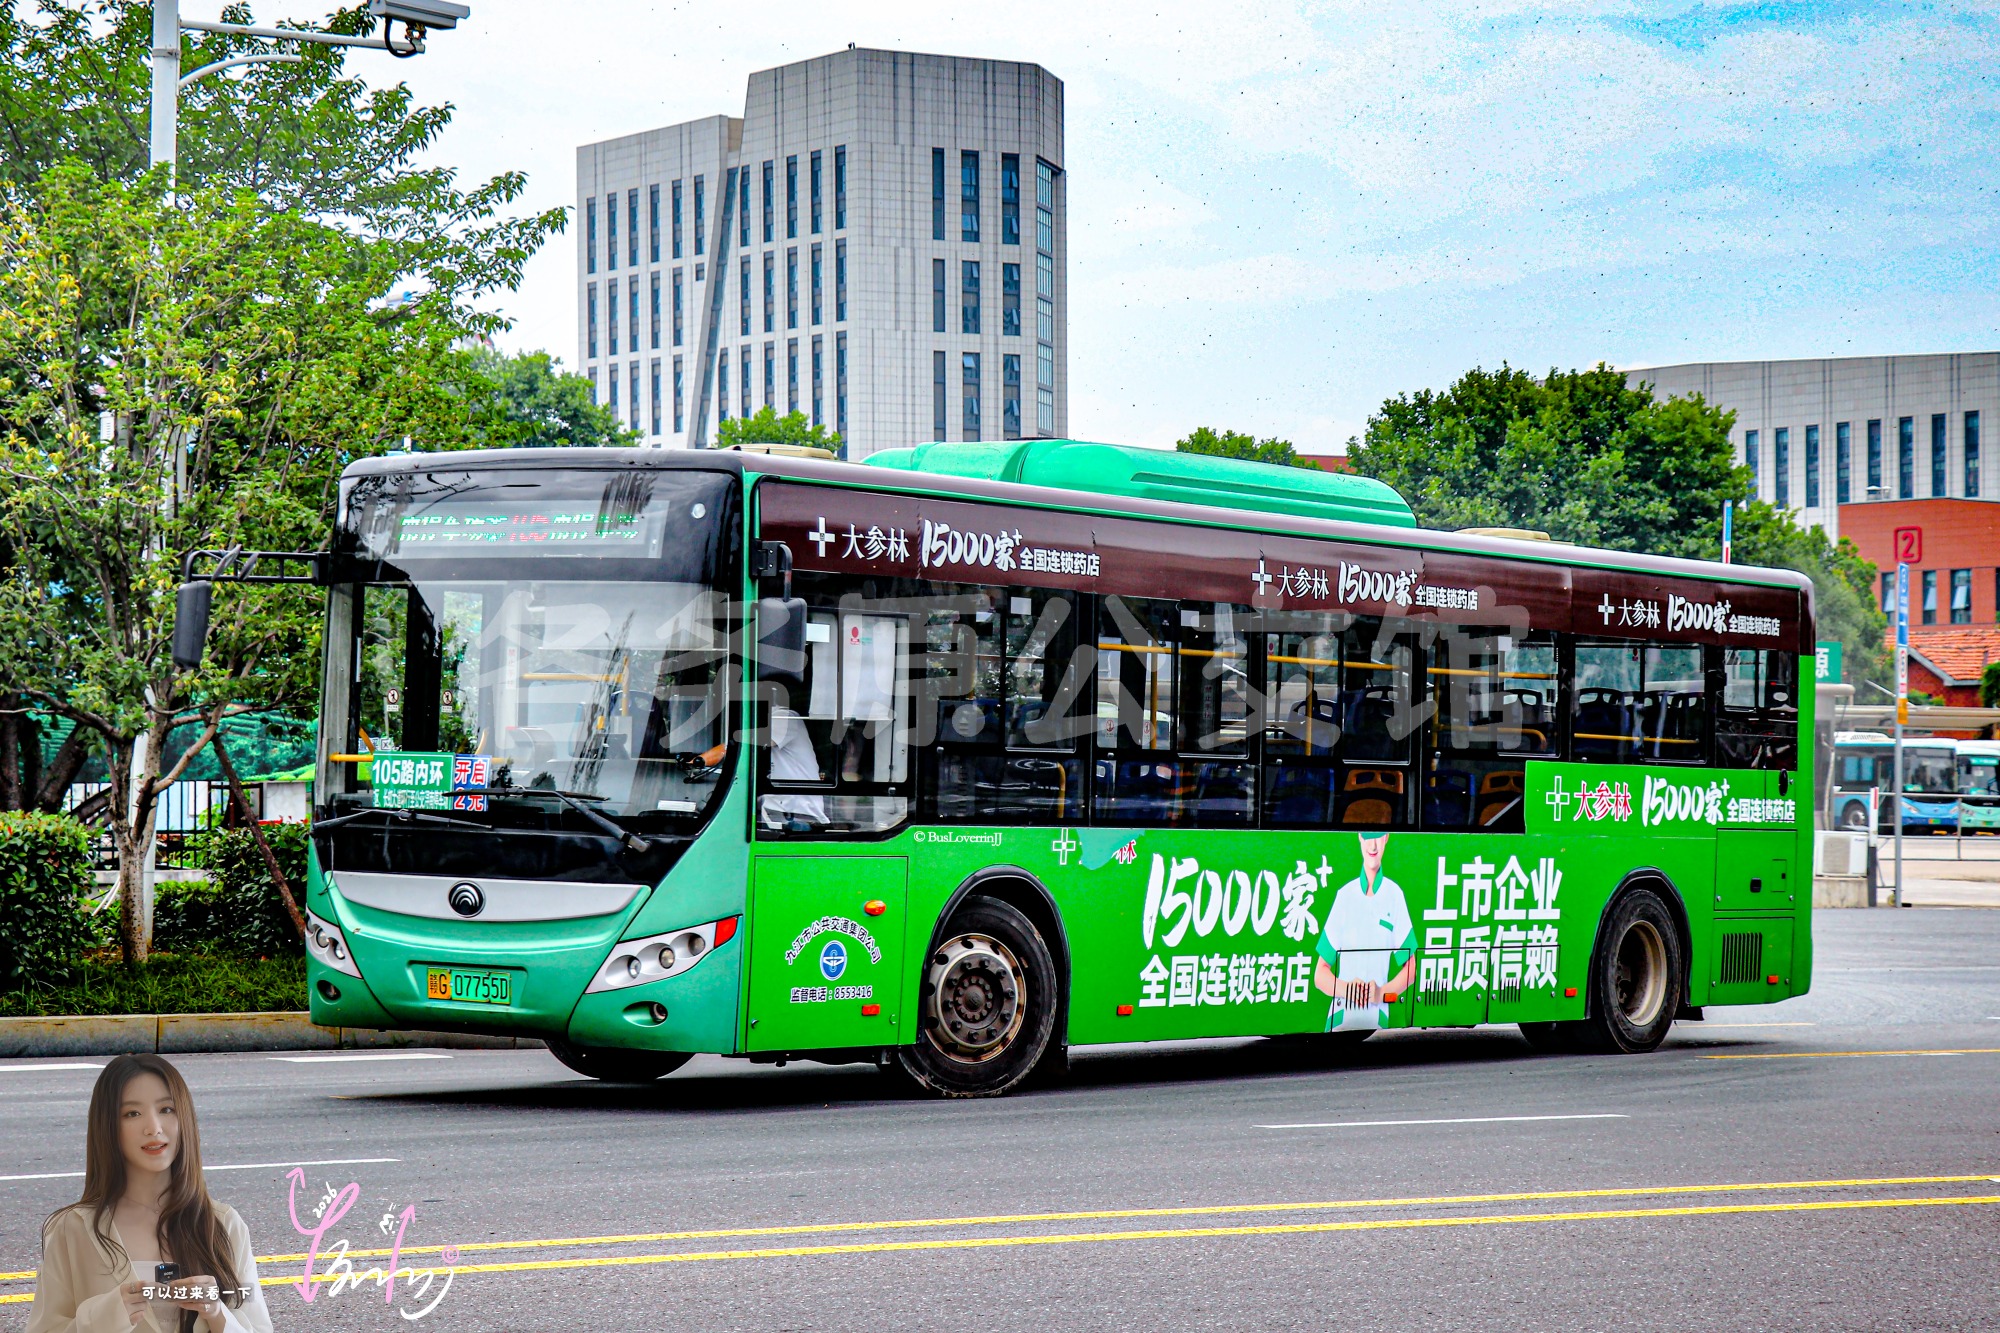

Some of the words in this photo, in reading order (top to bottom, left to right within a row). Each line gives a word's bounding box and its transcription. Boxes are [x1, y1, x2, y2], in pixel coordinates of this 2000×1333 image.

[842, 523, 910, 563] 大参林
[1019, 547, 1100, 577] 全国连锁药店
[1901, 531, 1914, 558] 2
[1276, 565, 1329, 600] 大参林
[1415, 584, 1478, 611] 全国连锁药店
[1618, 598, 1661, 629] 大参林
[1728, 614, 1780, 637] 全国连锁药店
[372, 759, 445, 787] 105路内环
[454, 760, 486, 786] 开启
[1573, 780, 1633, 822] 大参林
[1726, 797, 1796, 824] 全国连锁药店
[1423, 855, 1563, 922] 上市企业
[785, 916, 881, 965] 九江市公共交通集团公司
[1419, 924, 1559, 993] 品质信赖
[1139, 953, 1312, 1008] 全国连锁药店
